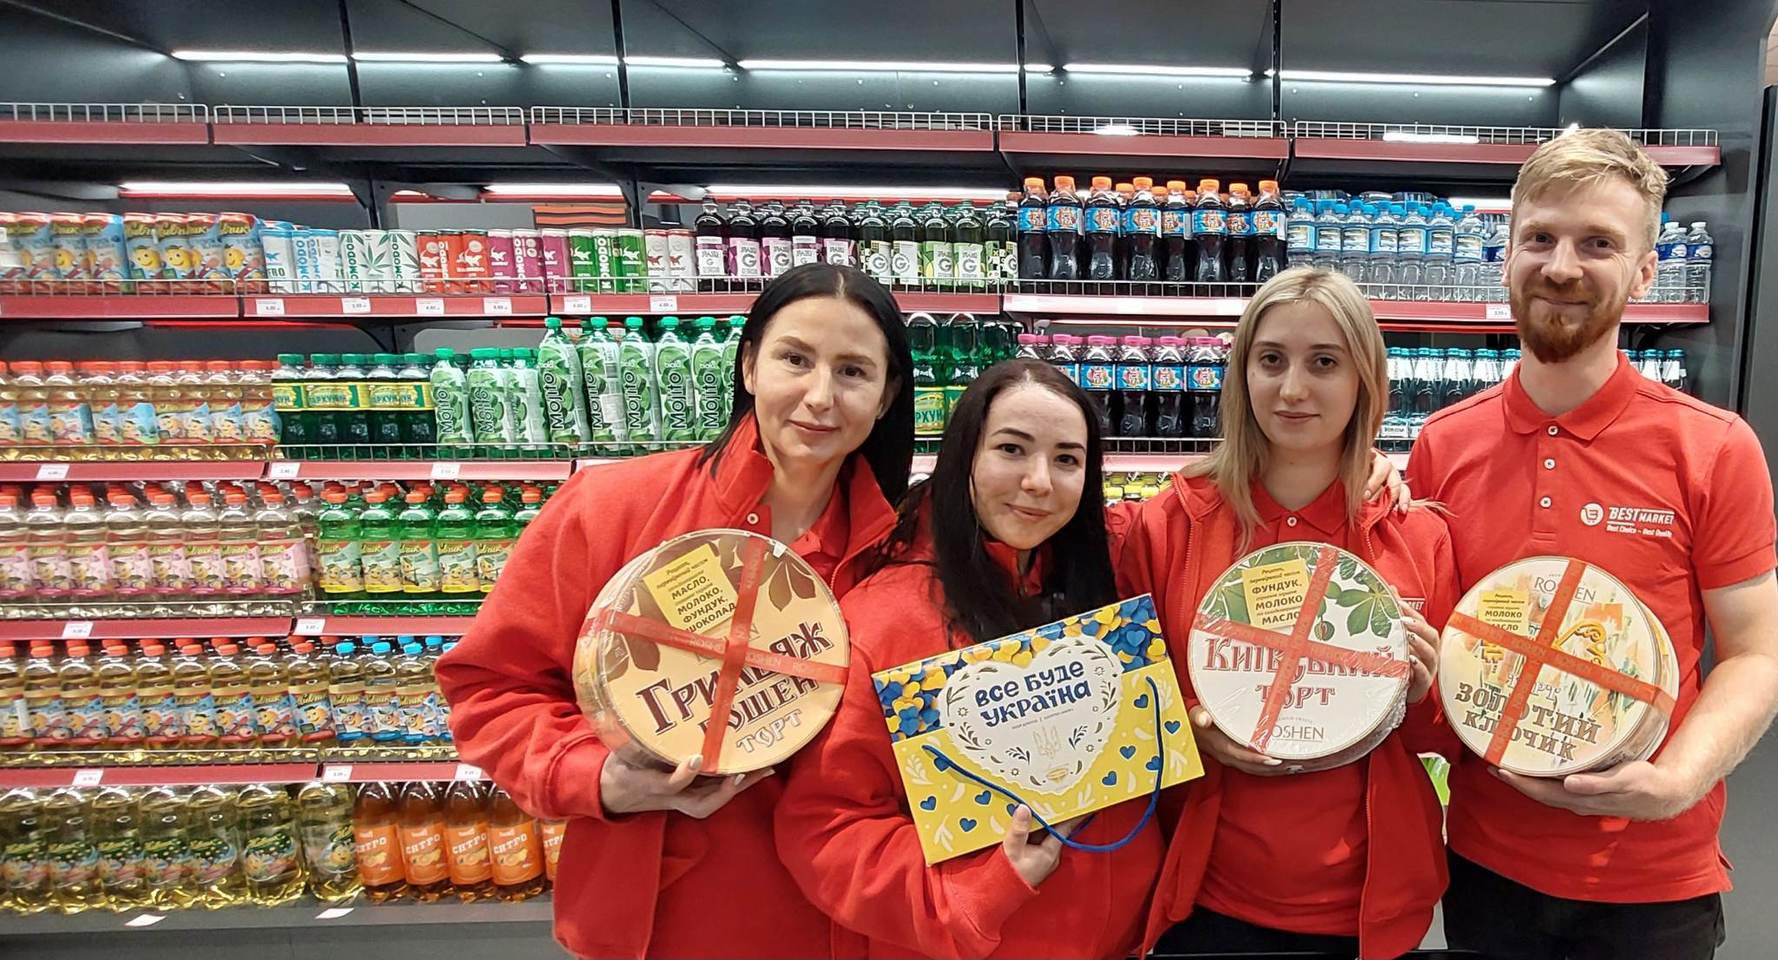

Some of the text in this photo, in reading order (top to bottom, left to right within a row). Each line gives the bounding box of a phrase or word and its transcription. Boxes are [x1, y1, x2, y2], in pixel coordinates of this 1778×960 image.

[346, 243, 360, 290] KOMODO
[514, 238, 528, 290] KOMODO
[598, 237, 612, 289] KOMODO
[438, 390, 454, 433] Mojito
[543, 371, 565, 430] Mojito
[585, 372, 604, 429] Mojito
[624, 370, 641, 429] Mojito
[667, 372, 687, 428] Mojito
[701, 373, 720, 428] Mojito
[1608, 507, 1675, 525] BEST MARKET
[1255, 594, 1303, 611] МОЛОКО
[1533, 576, 1597, 602] ROEN
[685, 602, 737, 633] ШОКОЛАД
[1484, 610, 1523, 619] МОЛОКО
[736, 709, 803, 754] ТОРТ
[1271, 724, 1325, 741] OSHEN
